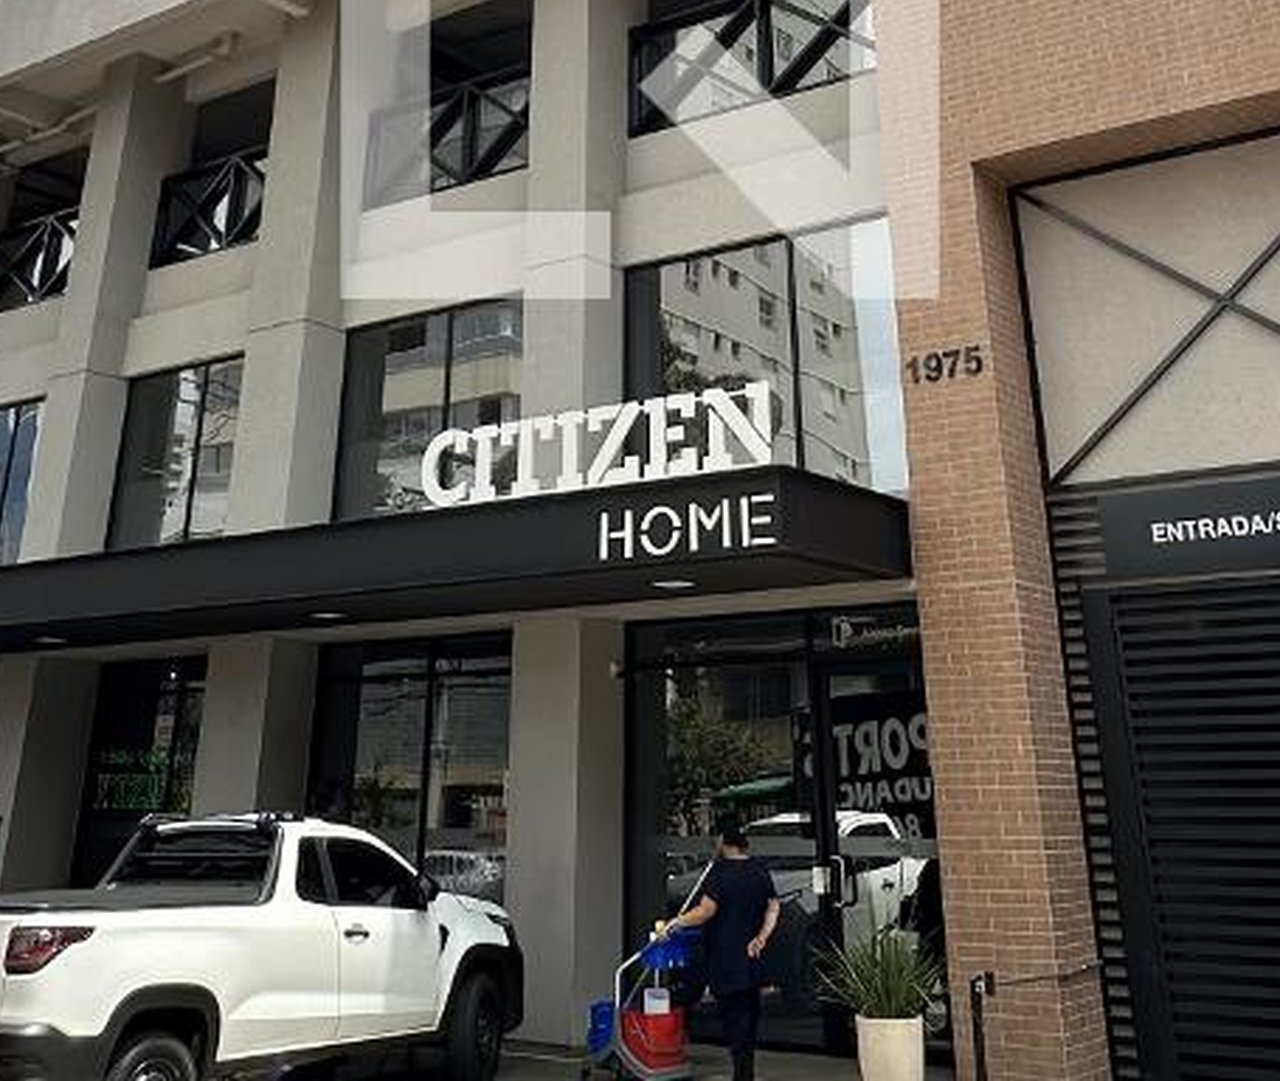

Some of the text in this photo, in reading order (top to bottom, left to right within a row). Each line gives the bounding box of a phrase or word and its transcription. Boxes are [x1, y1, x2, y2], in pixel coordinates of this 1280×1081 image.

[905, 344, 983, 384] 1975
[420, 380, 771, 508] CITIZEN
[598, 494, 777, 561] HOME
